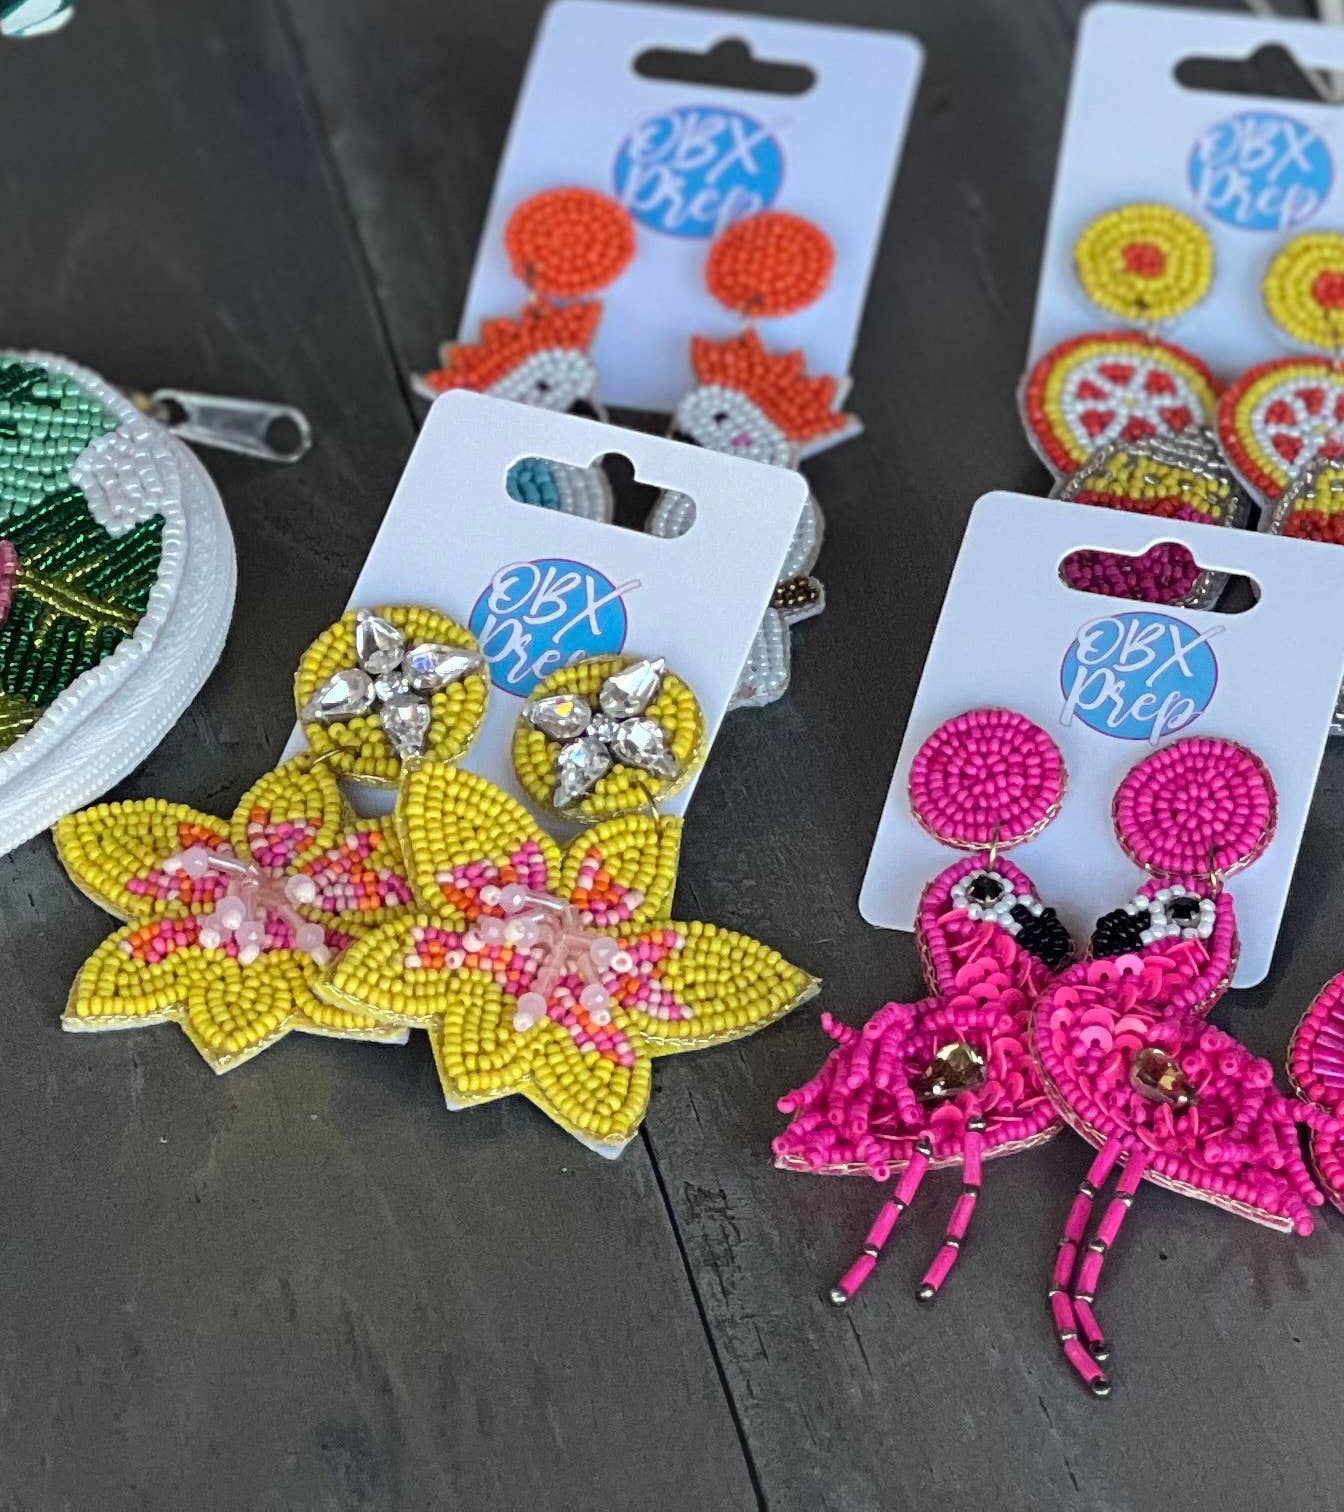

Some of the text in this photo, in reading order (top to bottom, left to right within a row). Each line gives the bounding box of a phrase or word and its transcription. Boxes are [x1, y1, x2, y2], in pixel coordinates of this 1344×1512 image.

[628, 109, 793, 184] OBX
[1200, 117, 1334, 183] OBX
[1192, 166, 1322, 233] Prep
[488, 562, 643, 643] OBX
[479, 614, 587, 684] Pre
[1076, 617, 1226, 687] OBX
[1059, 666, 1205, 746] Prep
